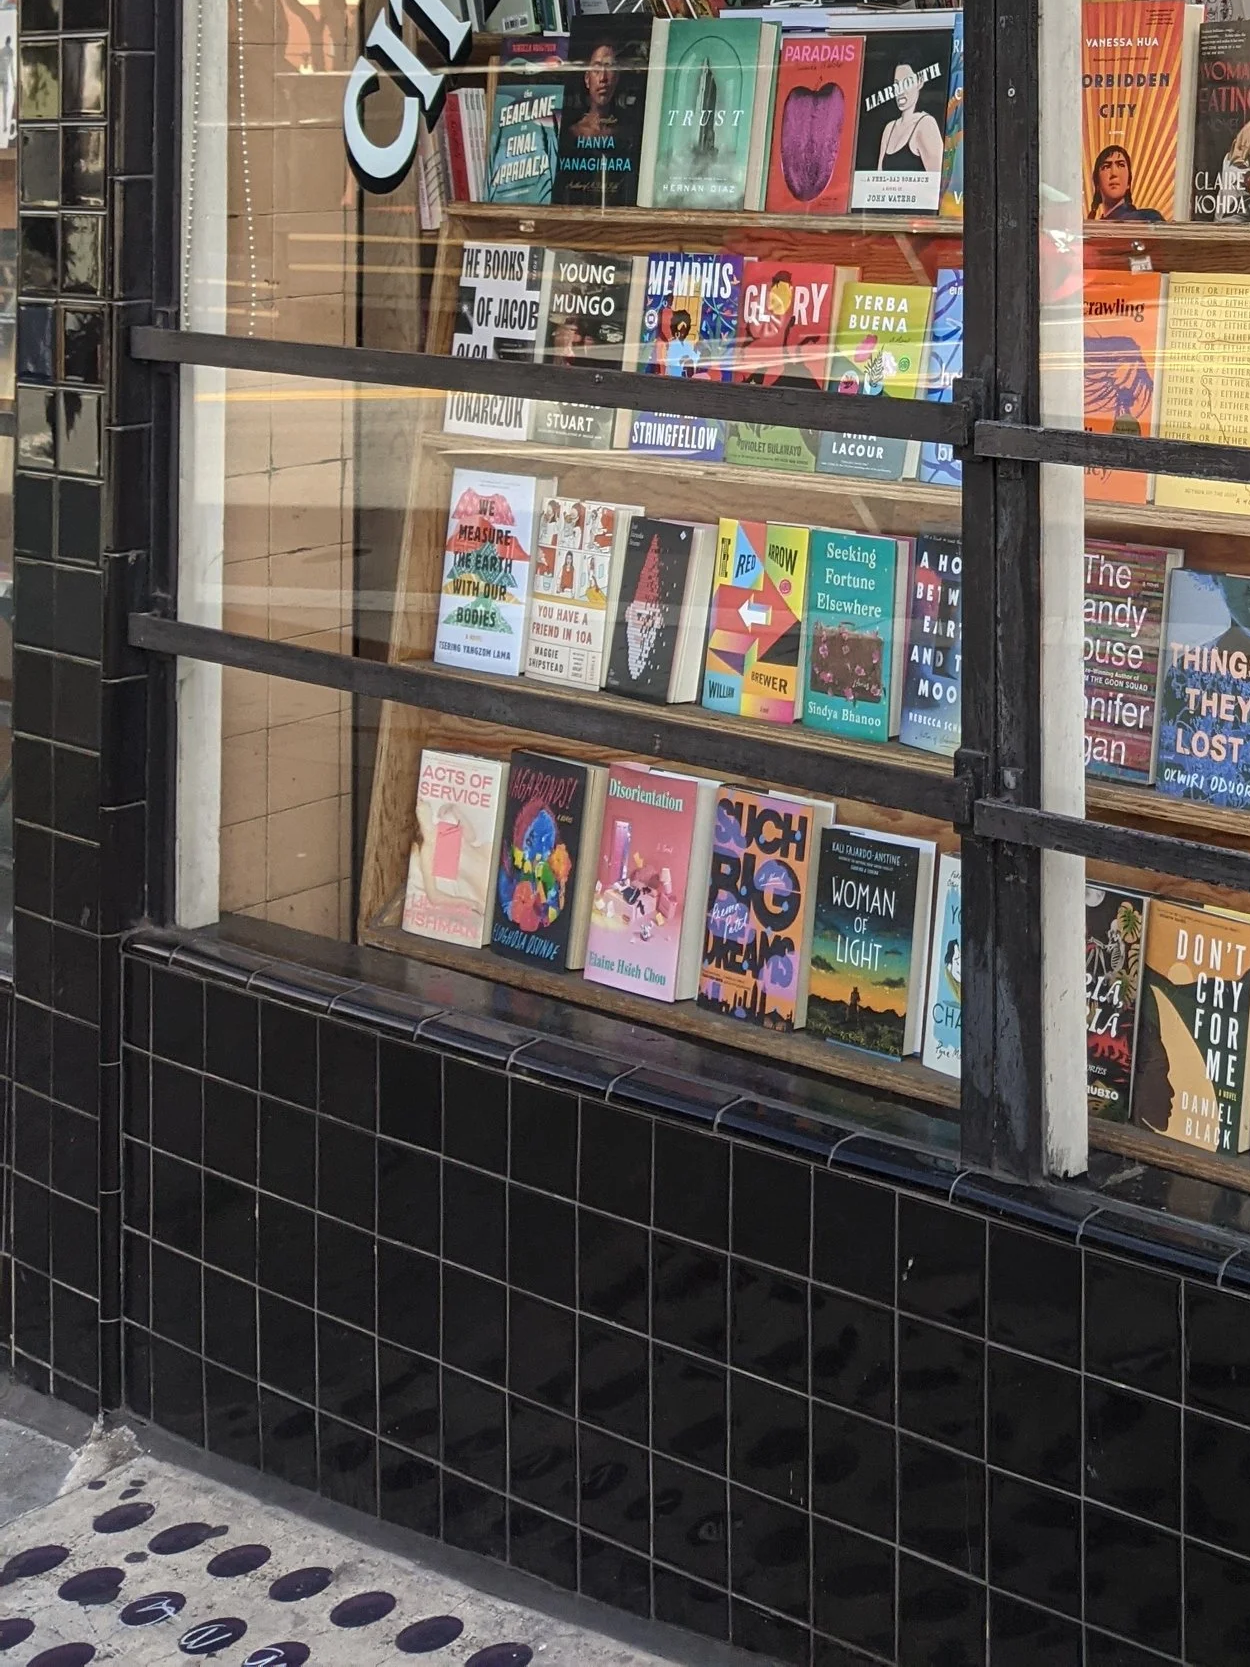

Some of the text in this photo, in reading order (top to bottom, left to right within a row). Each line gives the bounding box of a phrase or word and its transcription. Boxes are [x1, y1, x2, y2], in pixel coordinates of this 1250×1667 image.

[1086, 38, 1158, 47] VANESSA HUA
[784, 45, 854, 62] PARADAIS
[500, 95, 555, 127] SEAPLANE
[668, 110, 744, 126] TRUST
[1100, 104, 1136, 118] CITY
[577, 136, 615, 149] HANYA
[559, 158, 631, 171] YANAGIHARA
[710, 185, 735, 193] DIAZ
[1195, 172, 1245, 190] CLAIRE
[867, 195, 916, 203] JOHN WATERS
[1195, 195, 1246, 214] KOHDA
[560, 263, 615, 284] YOUNG
[477, 297, 539, 330] OF JACOB
[553, 294, 614, 316] MUNGO
[854, 296, 908, 312] YERBA
[849, 315, 907, 333] BUENA
[546, 414, 593, 432] STUART
[832, 442, 884, 459] LACOUR
[479, 499, 495, 517] WE
[459, 525, 511, 546] MEASURE
[454, 553, 512, 573] THE EARTH
[768, 545, 797, 575] ARROW
[827, 543, 876, 568] Seeking
[453, 579, 506, 600] WITH OUR
[825, 568, 875, 590] Fortune
[538, 605, 588, 625] YOU HAVE A
[817, 593, 882, 617] Elsewhere
[456, 607, 496, 627] BODIES
[532, 622, 592, 644] FRIEND IN 10A
[535, 646, 558, 658] MAGGIE
[529, 658, 564, 673] SHIPSTEAD
[751, 671, 787, 694] BREWER
[808, 701, 881, 726] Sindya Bhanoo
[1176, 728, 1243, 763] LOST
[422, 765, 493, 787] ACTS OF
[420, 781, 491, 807] SERVICE
[609, 778, 684, 812] Disorientation
[832, 876, 896, 918] WOMAN
[854, 917, 868, 933] OF
[836, 935, 882, 970] LIGHT
[1196, 972, 1243, 1013] CRY
[1194, 1008, 1238, 1050] FOR
[1206, 1049, 1237, 1088] ME
[1182, 1092, 1232, 1125] DANIEL
[1185, 1117, 1231, 1150] BLACK
